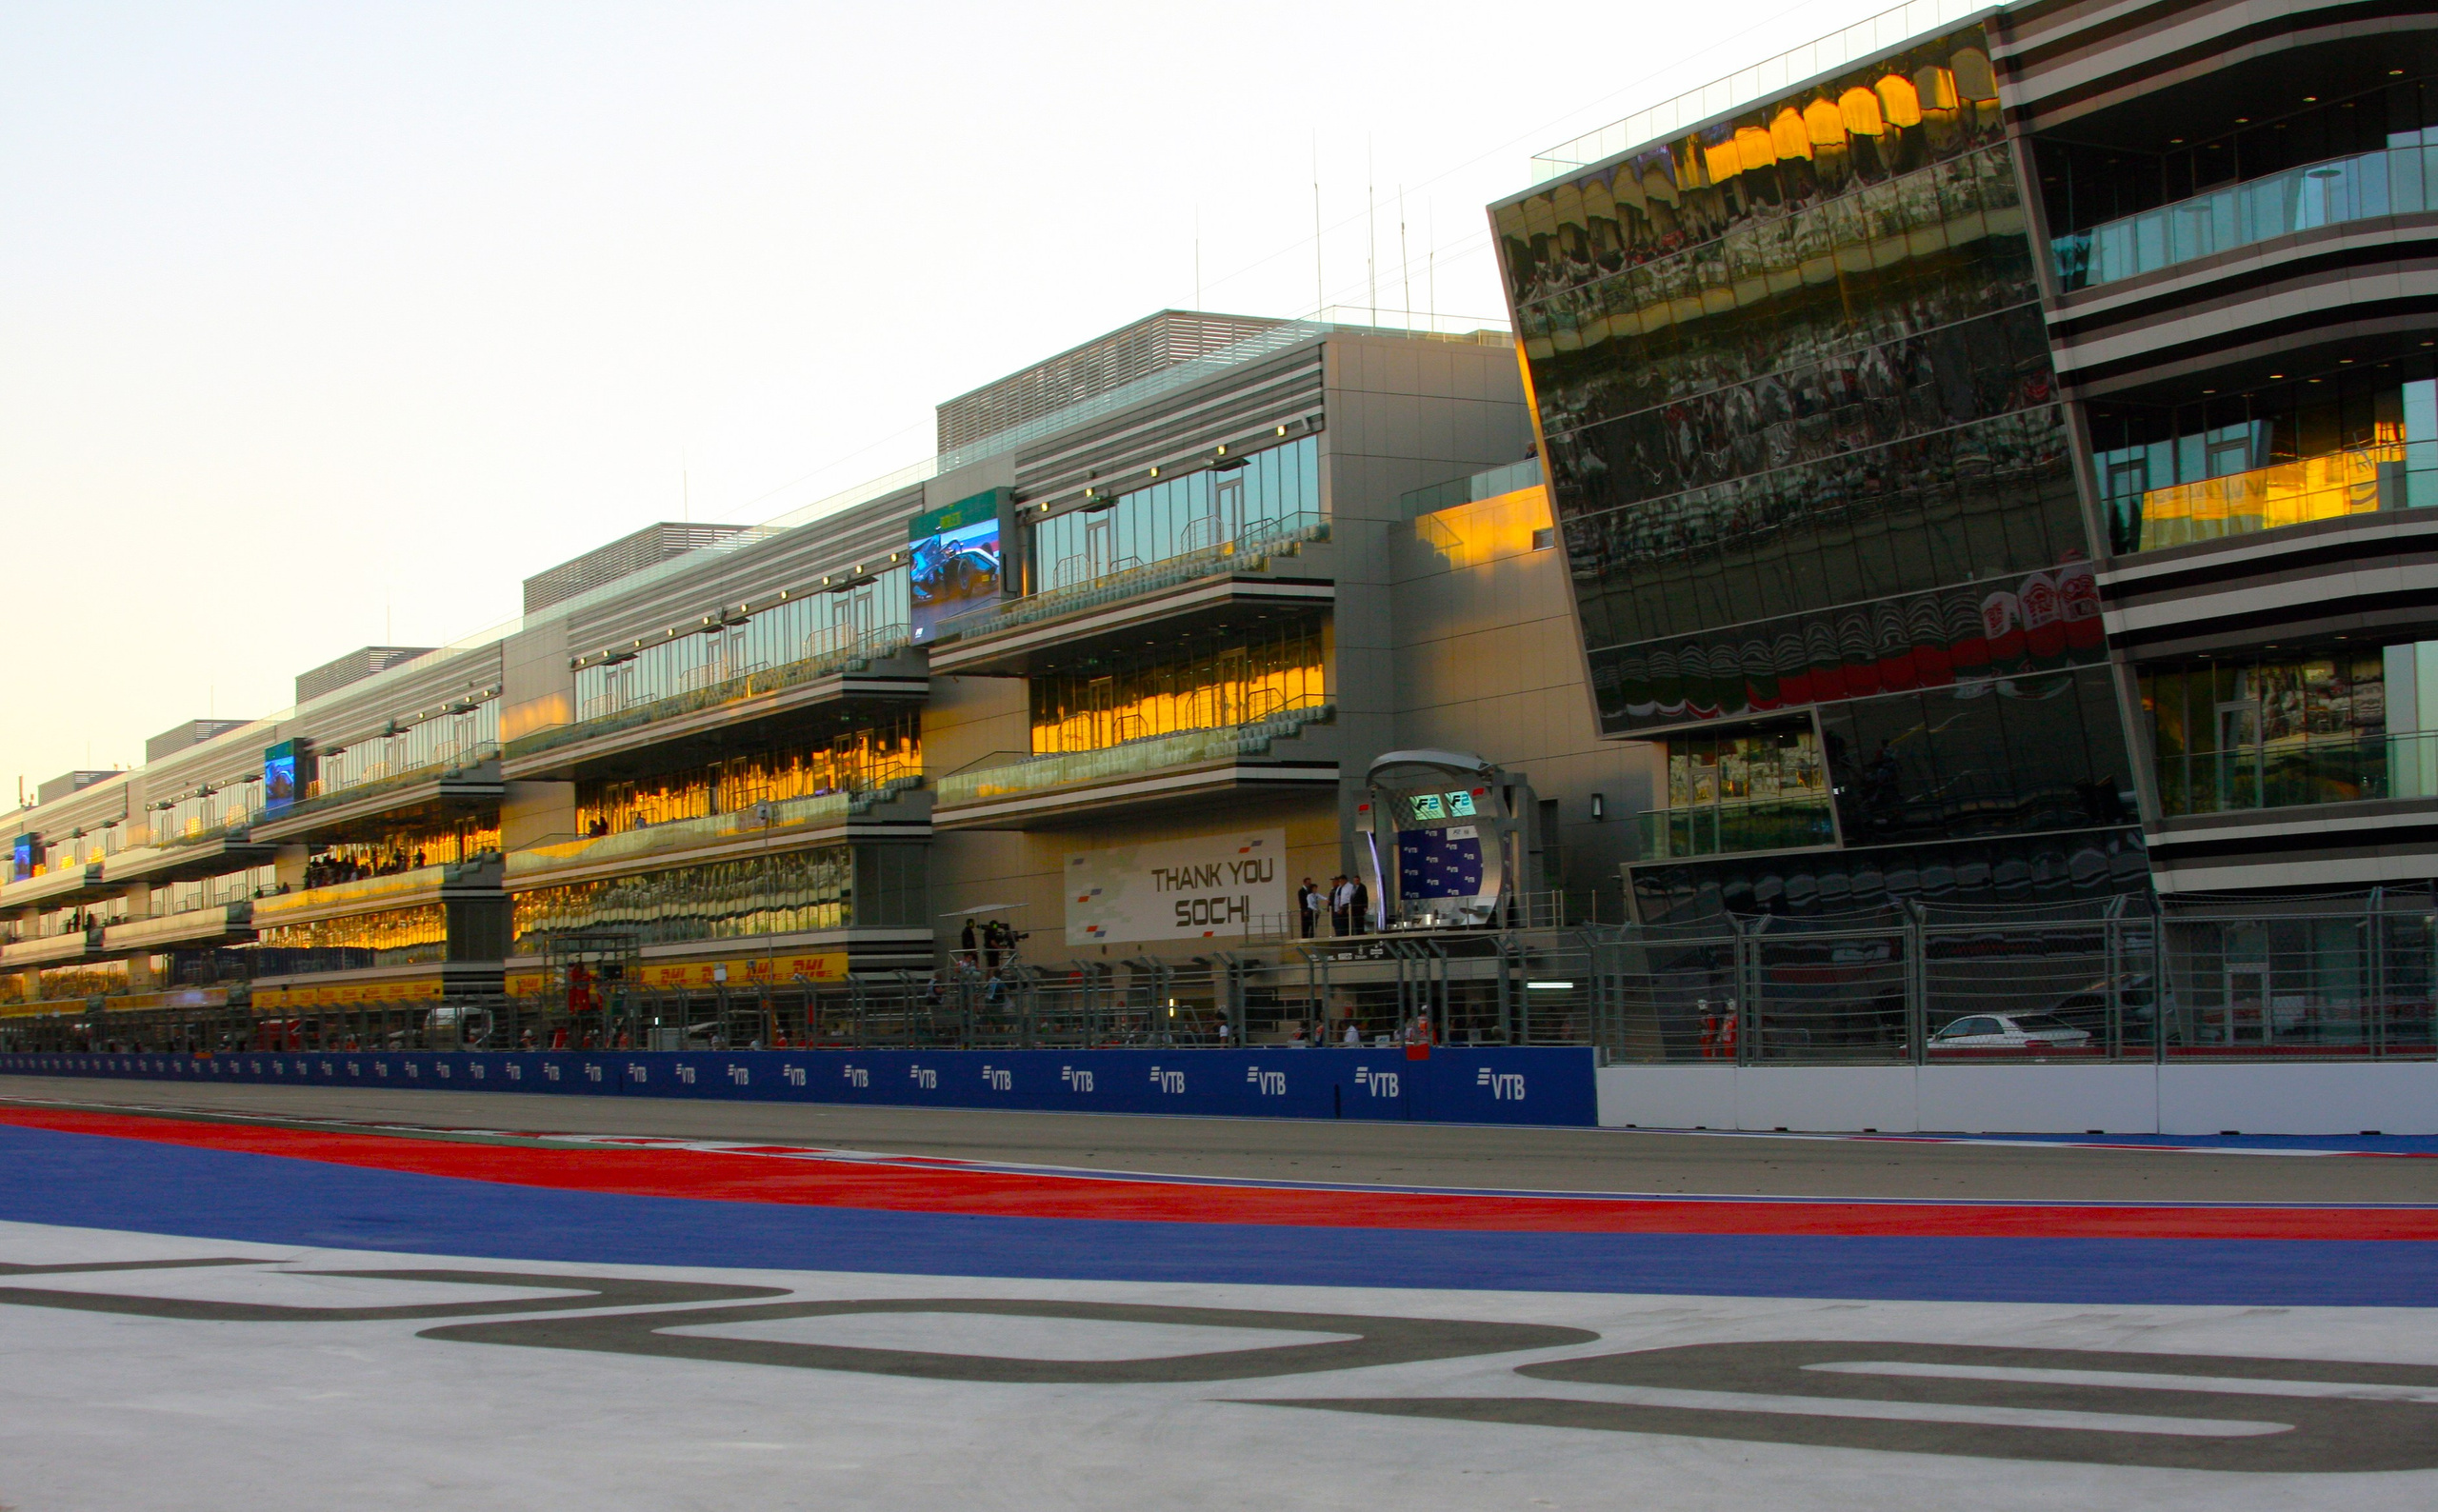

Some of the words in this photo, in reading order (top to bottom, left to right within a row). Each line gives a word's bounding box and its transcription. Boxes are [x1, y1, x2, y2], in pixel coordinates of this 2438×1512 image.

[1416, 797, 1439, 810] F2
[1451, 794, 1469, 806] F2
[1151, 863, 1222, 893] THANK
[1228, 857, 1273, 885] YOU
[1175, 895, 1249, 927] SOCHI
[792, 958, 827, 978] DHL
[683, 1065, 695, 1084] VTB
[735, 1066, 749, 1085] VTB
[790, 1067, 806, 1086] VTB
[852, 1067, 869, 1087] VTB
[919, 1069, 937, 1089] VTB
[991, 1069, 1011, 1090] VTB
[1070, 1070, 1093, 1092] VTB
[1160, 1071, 1186, 1094] VTB
[1259, 1071, 1287, 1095] VTB
[1369, 1072, 1399, 1098] VTB
[1492, 1073, 1526, 1101] VTB
